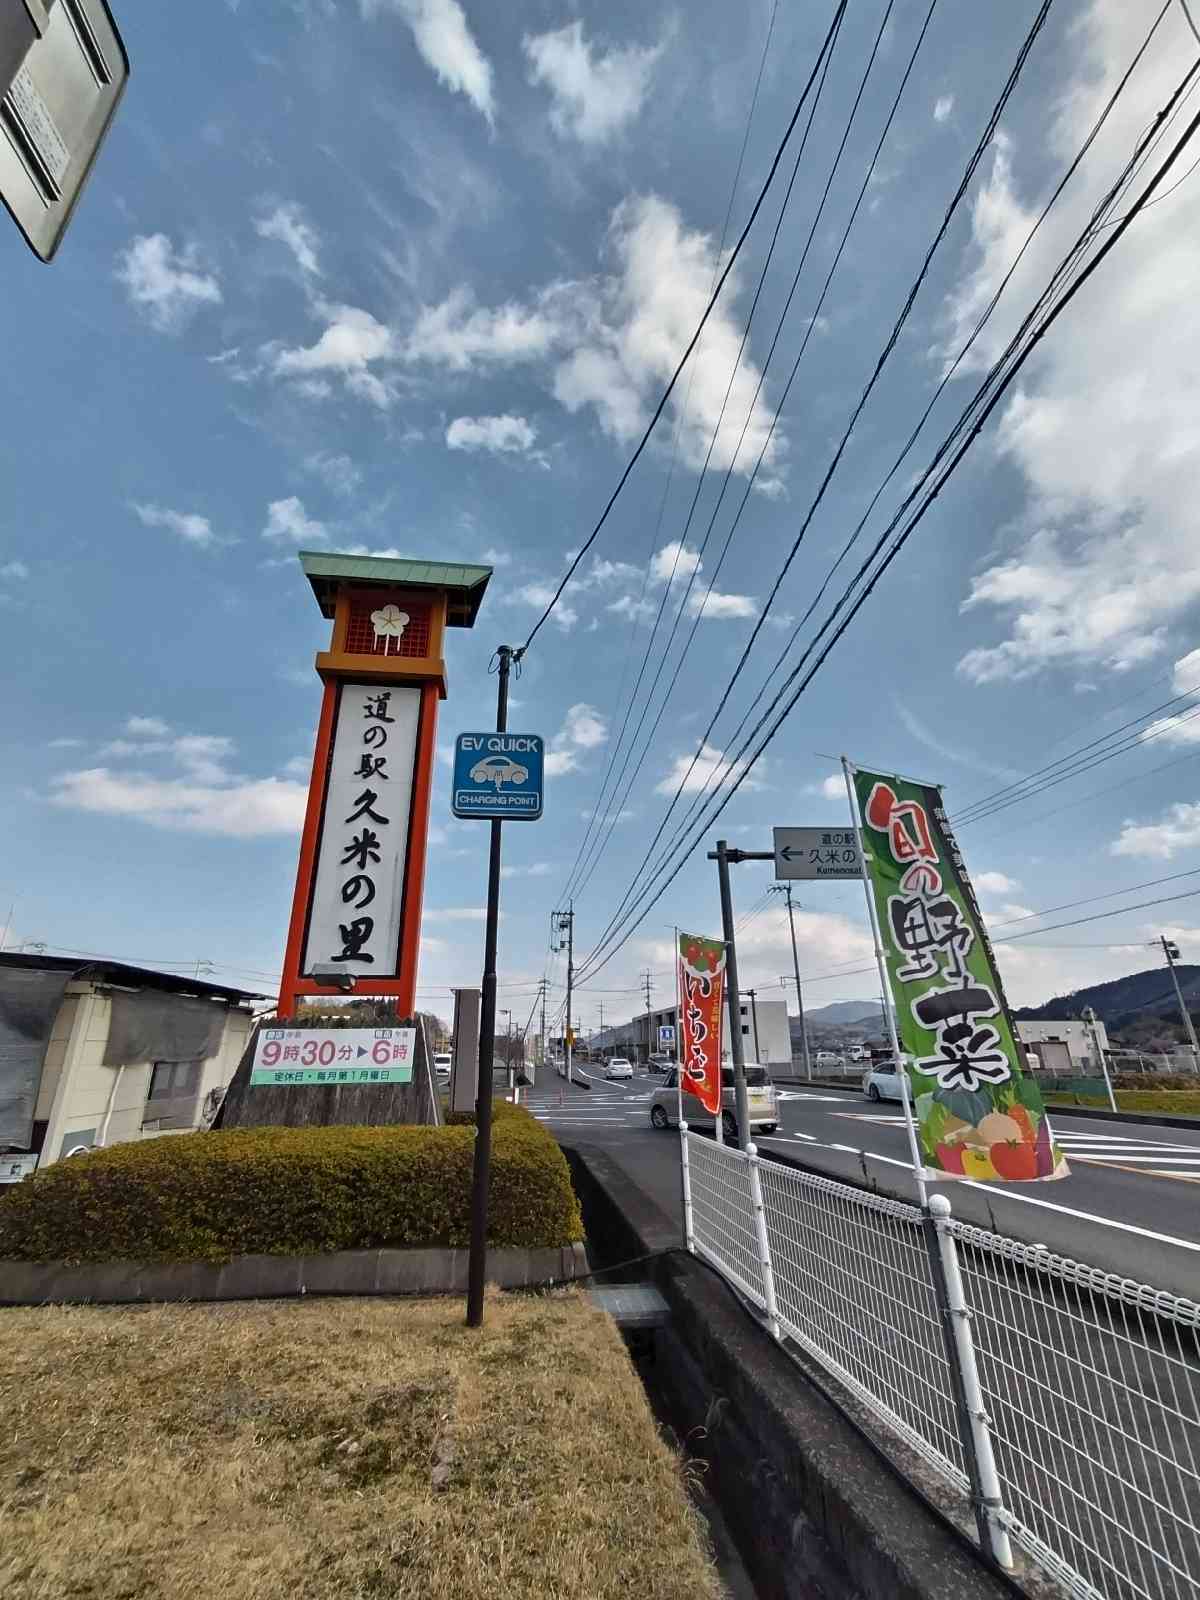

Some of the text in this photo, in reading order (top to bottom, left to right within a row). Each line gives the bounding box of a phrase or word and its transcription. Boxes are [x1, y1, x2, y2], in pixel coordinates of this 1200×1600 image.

[461, 737, 538, 752] EV QUICK
[459, 795, 536, 806] CHARGING POINT
[331, 692, 395, 964] 道の駅久米の里
[821, 832, 856, 845] 道の駅
[816, 866, 864, 875] Kumenosat
[261, 1040, 408, 1066] 9時30分 6時
